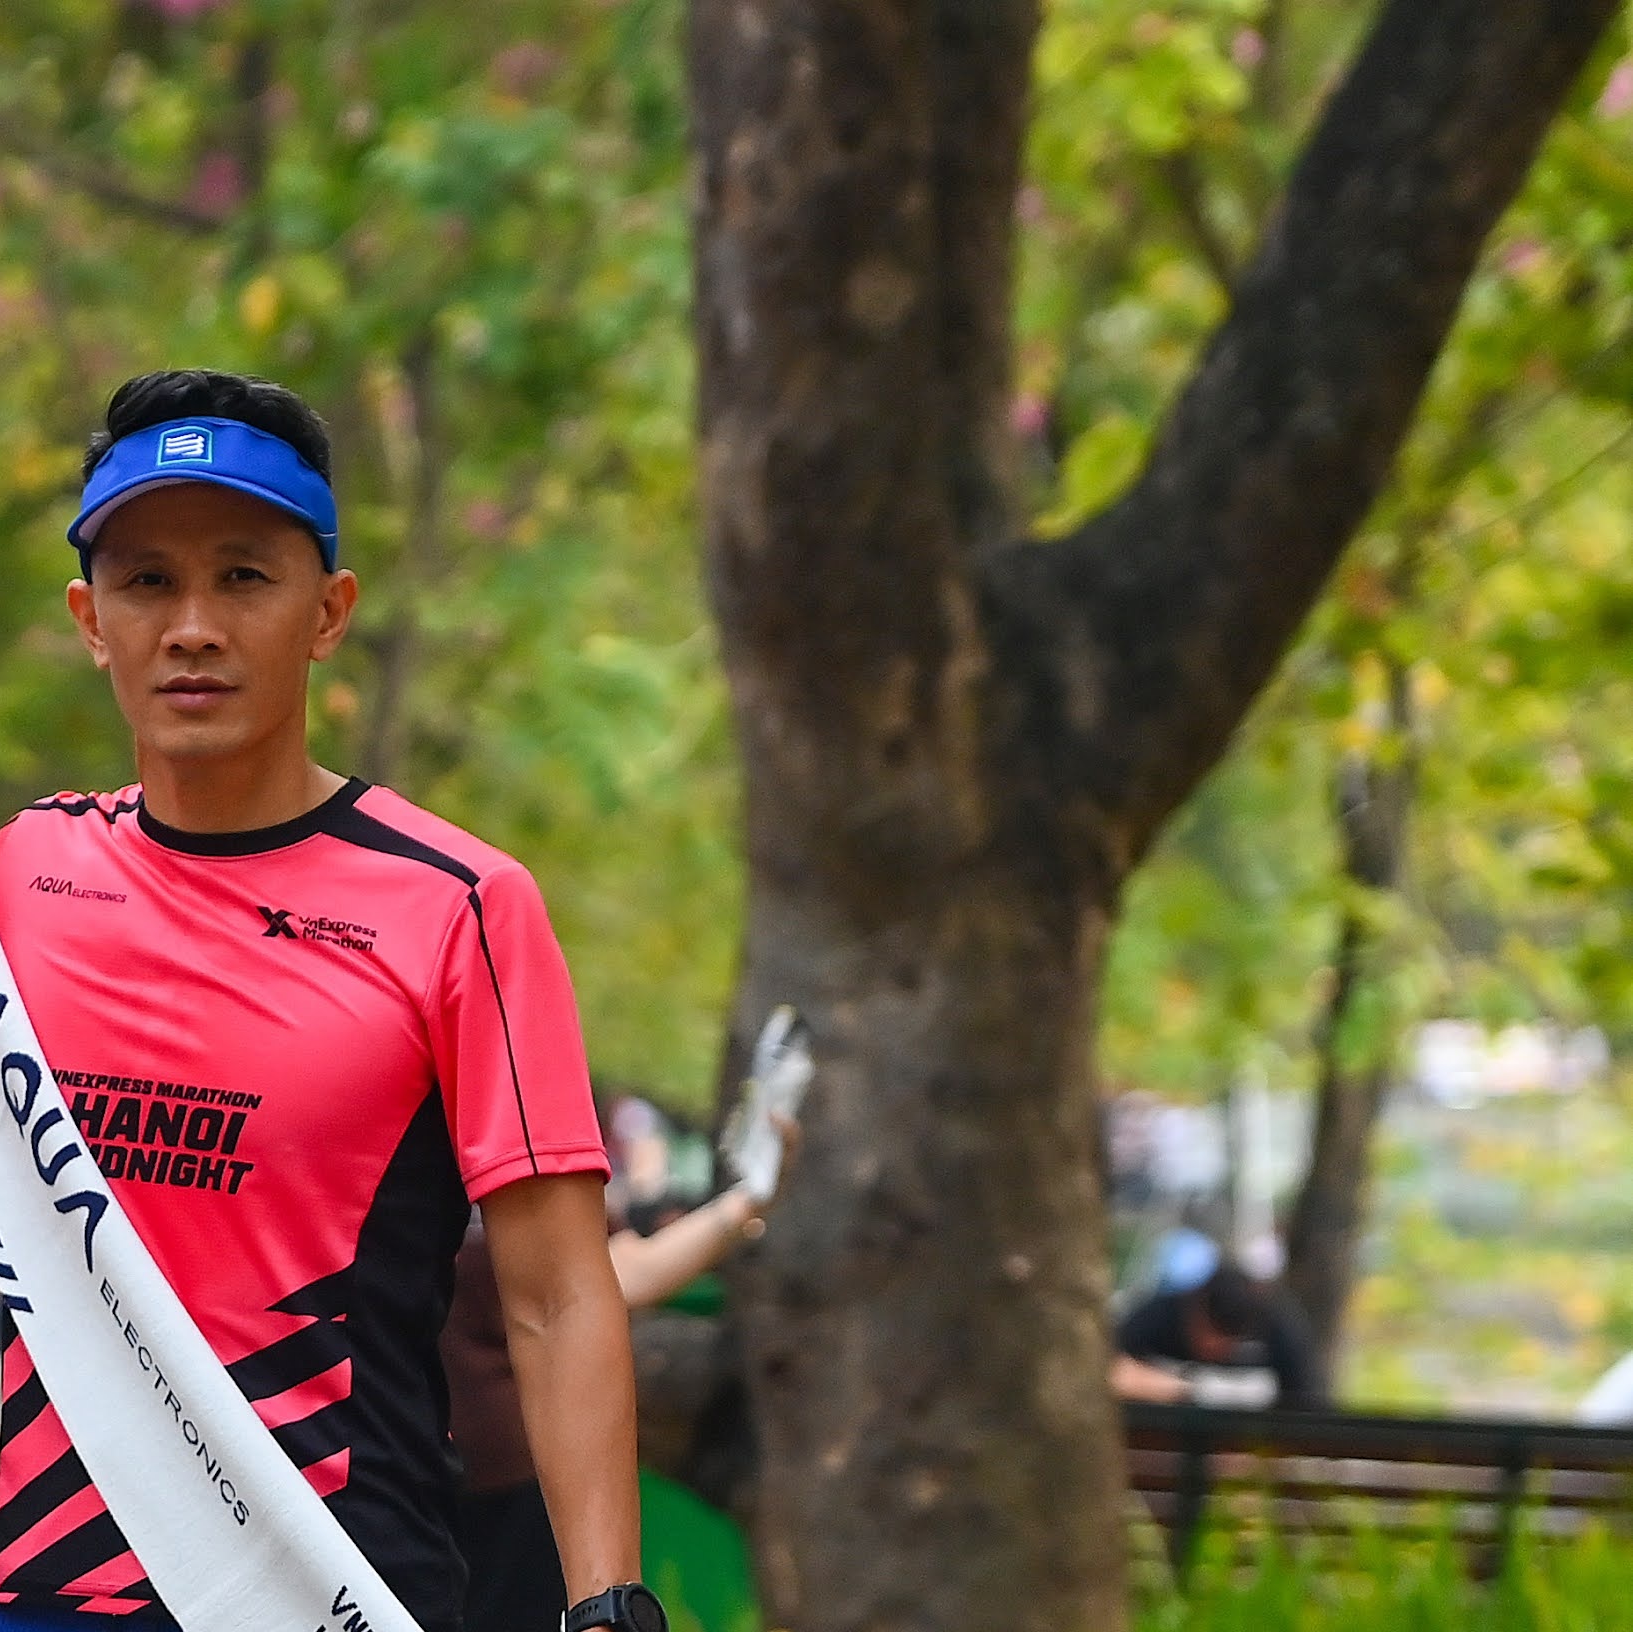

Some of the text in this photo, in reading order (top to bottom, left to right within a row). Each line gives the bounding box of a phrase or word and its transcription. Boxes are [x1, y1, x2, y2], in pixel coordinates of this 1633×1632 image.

[29, 875, 73, 895] AQUA
[298, 916, 377, 938] VnExpress
[155, 1081, 263, 1110] MARATHON
[70, 1092, 248, 1155] HANOI
[85, 1142, 255, 1195] IDNIGHT
[99, 1277, 251, 1527] ELECTRONICS
